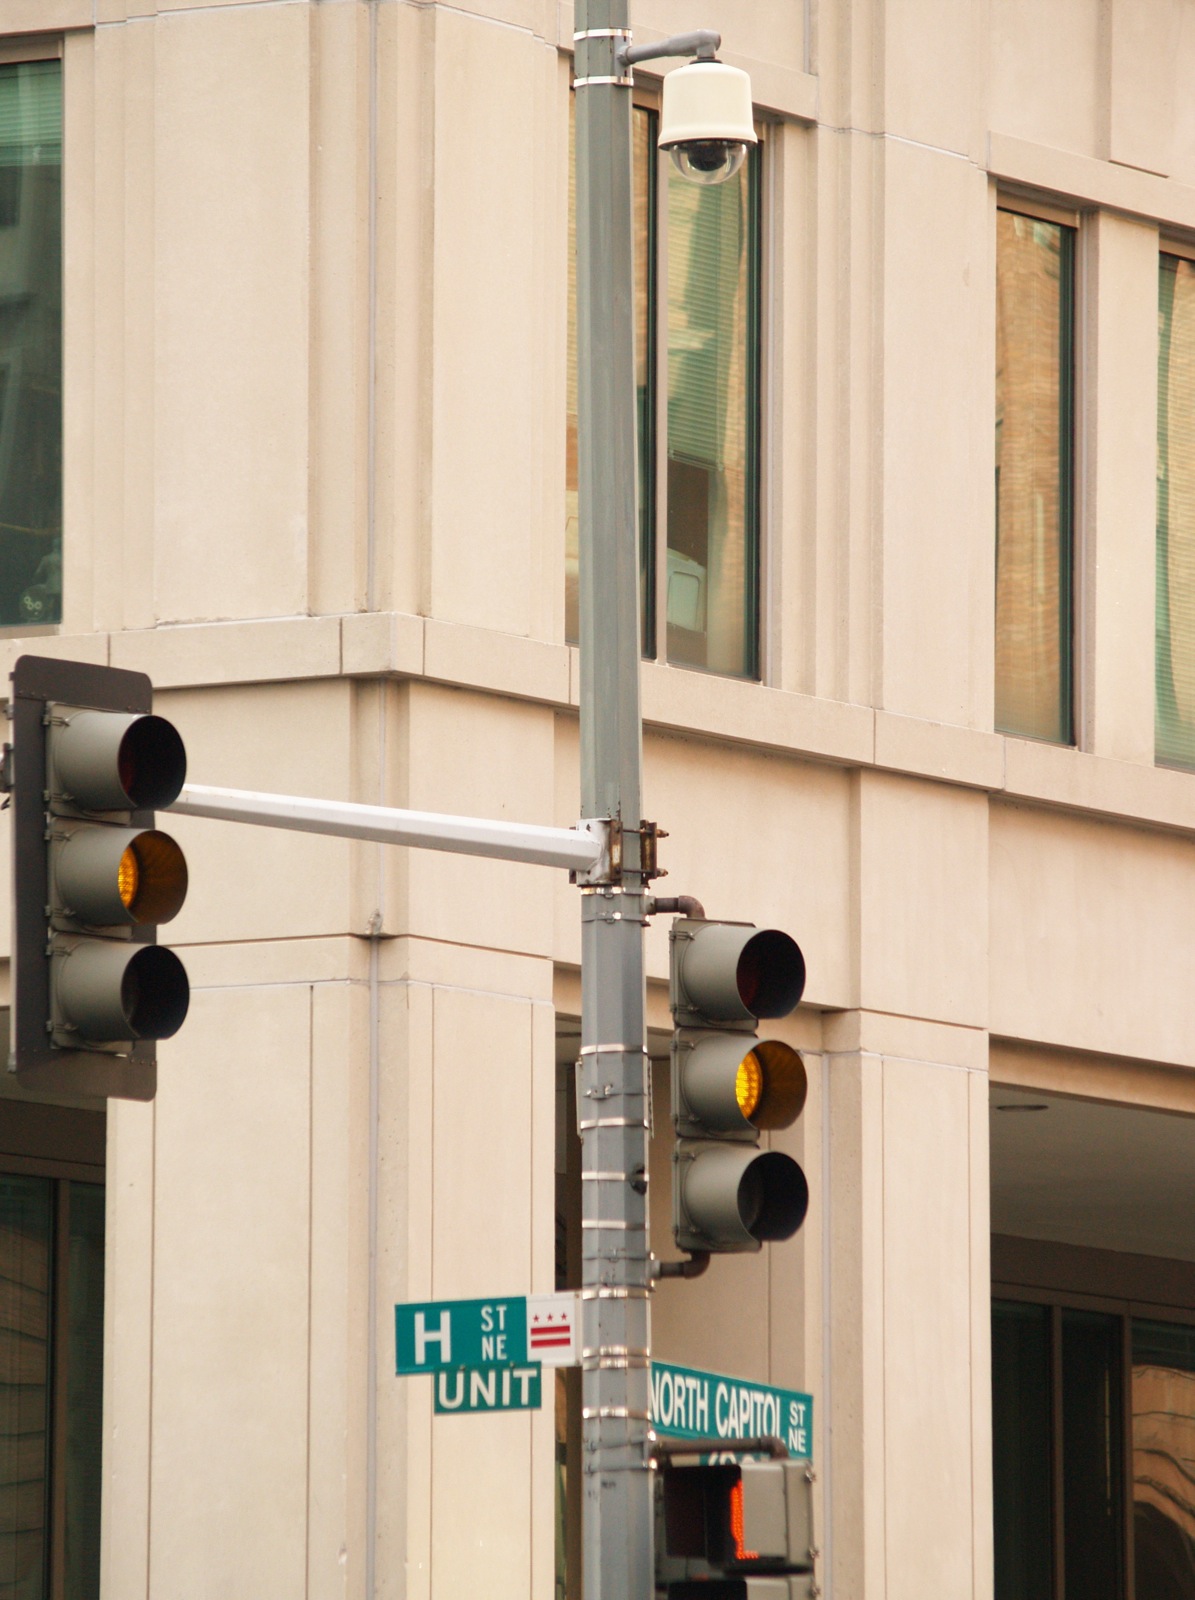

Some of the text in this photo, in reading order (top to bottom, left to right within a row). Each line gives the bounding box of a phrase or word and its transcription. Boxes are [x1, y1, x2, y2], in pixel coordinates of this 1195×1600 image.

[414, 1305, 507, 1365] H ST
[481, 1335, 507, 1362] NE
[438, 1368, 538, 1409] UNIT
[651, 1370, 806, 1445] NORTH CAPITOL ST
[788, 1428, 806, 1453] NE
